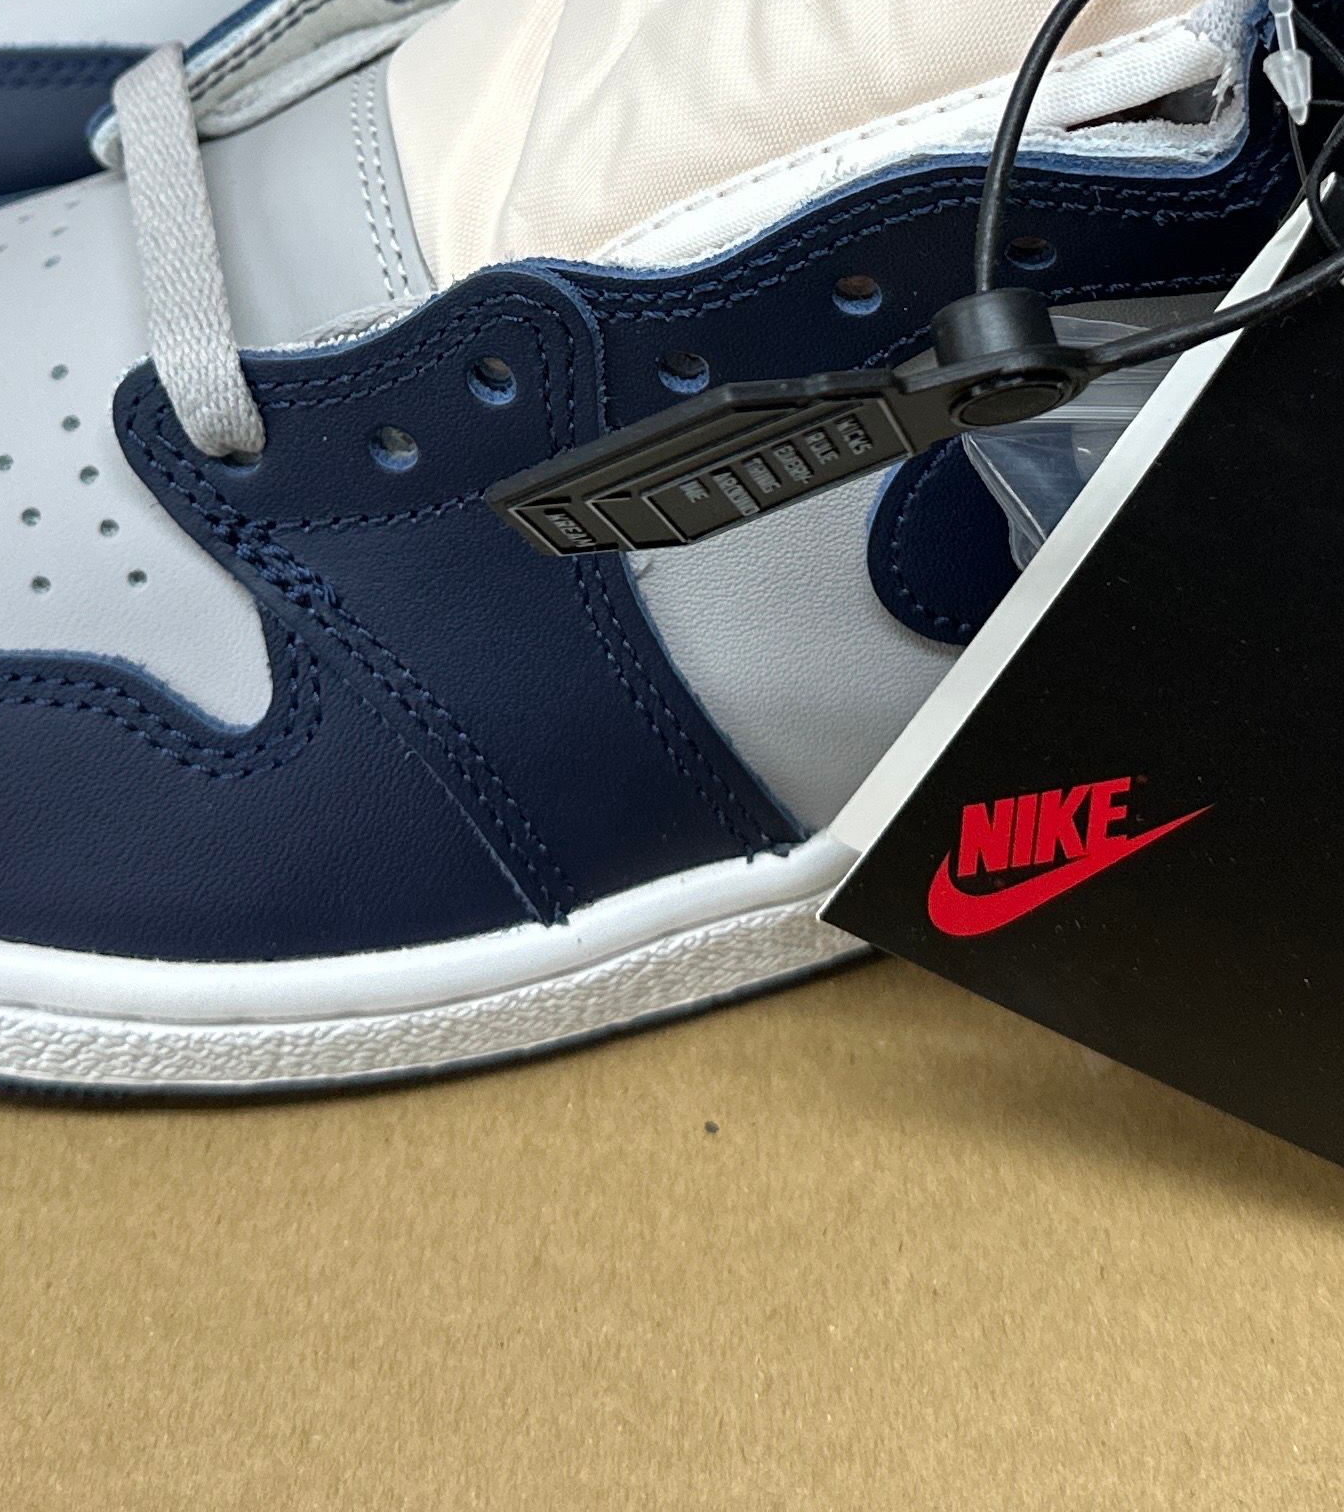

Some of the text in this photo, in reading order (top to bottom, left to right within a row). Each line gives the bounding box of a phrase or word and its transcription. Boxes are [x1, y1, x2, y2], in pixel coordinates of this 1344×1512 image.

[807, 430, 841, 465] RULE
[836, 415, 873, 456] KICKS
[545, 512, 597, 548] KREAM
[957, 776, 1132, 878] NIKE
